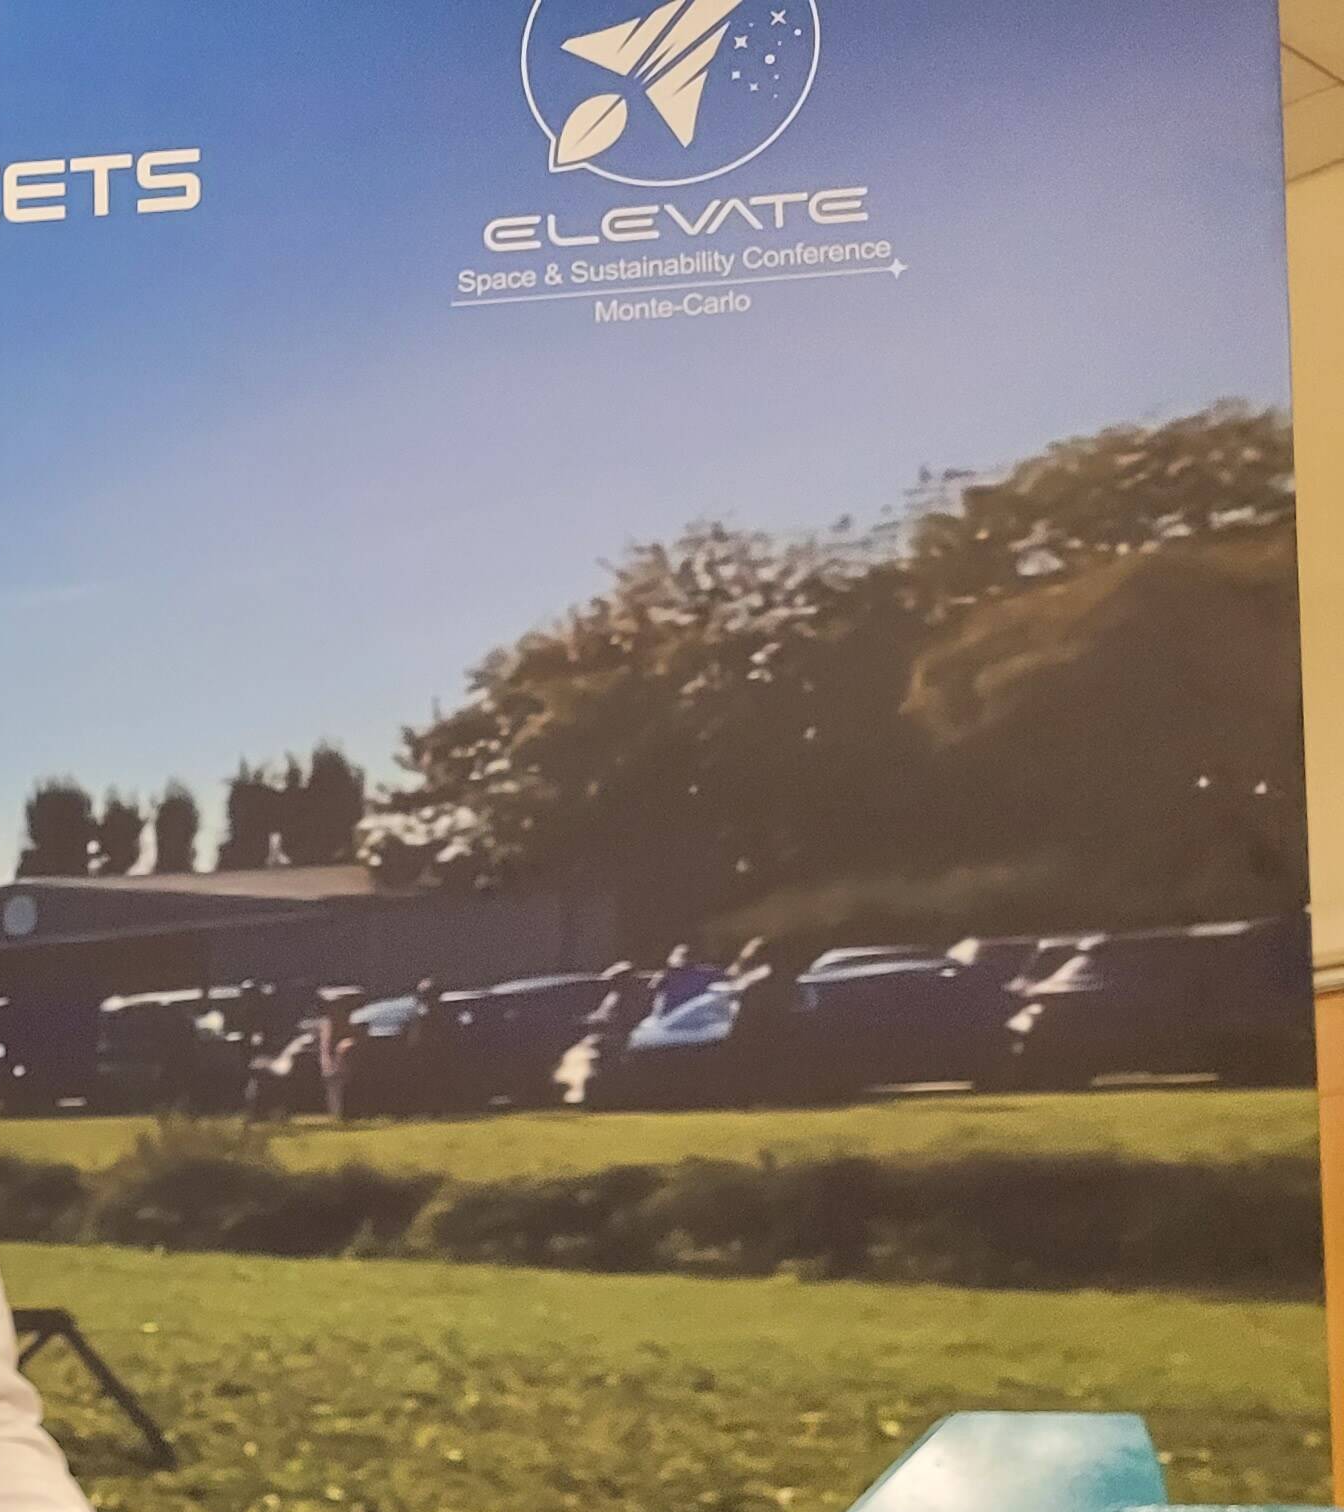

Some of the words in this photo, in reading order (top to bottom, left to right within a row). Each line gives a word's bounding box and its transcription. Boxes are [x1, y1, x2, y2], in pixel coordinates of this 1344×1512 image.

[483, 187, 868, 251] ELEVATE
[458, 269, 536, 295] Space
[544, 265, 562, 286] &
[571, 250, 735, 283] Sustainability
[743, 239, 891, 268] Conference
[594, 289, 751, 323] Monte-Carlo
